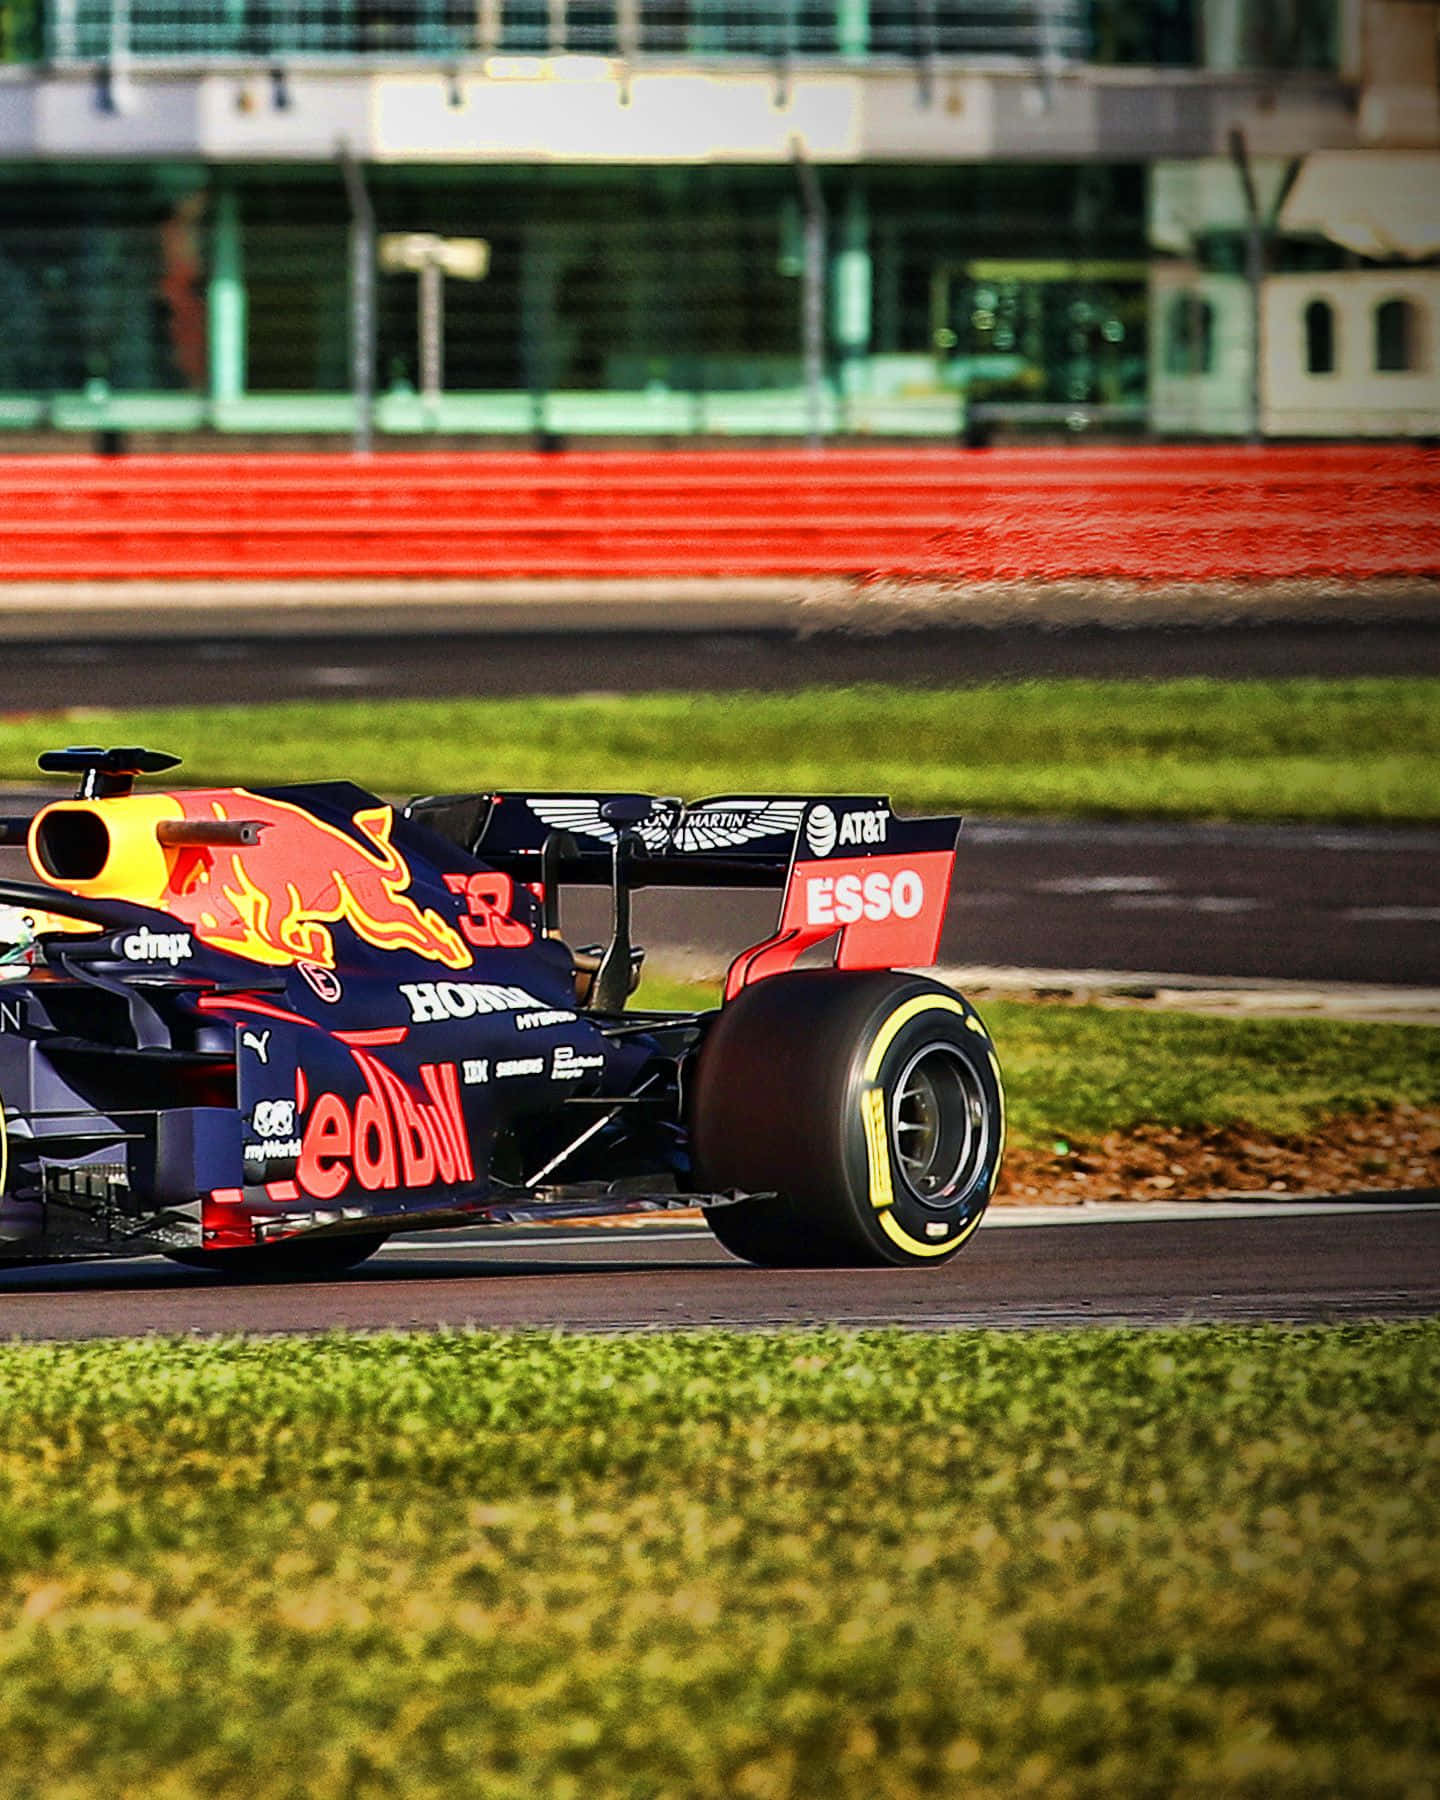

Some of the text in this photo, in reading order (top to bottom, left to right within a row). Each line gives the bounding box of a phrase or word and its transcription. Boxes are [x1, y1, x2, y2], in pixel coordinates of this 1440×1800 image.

[685, 812, 748, 828] MARTIN
[839, 810, 890, 845] AT&T
[807, 870, 923, 925] ESSO
[399, 982, 553, 1024] HONDA
